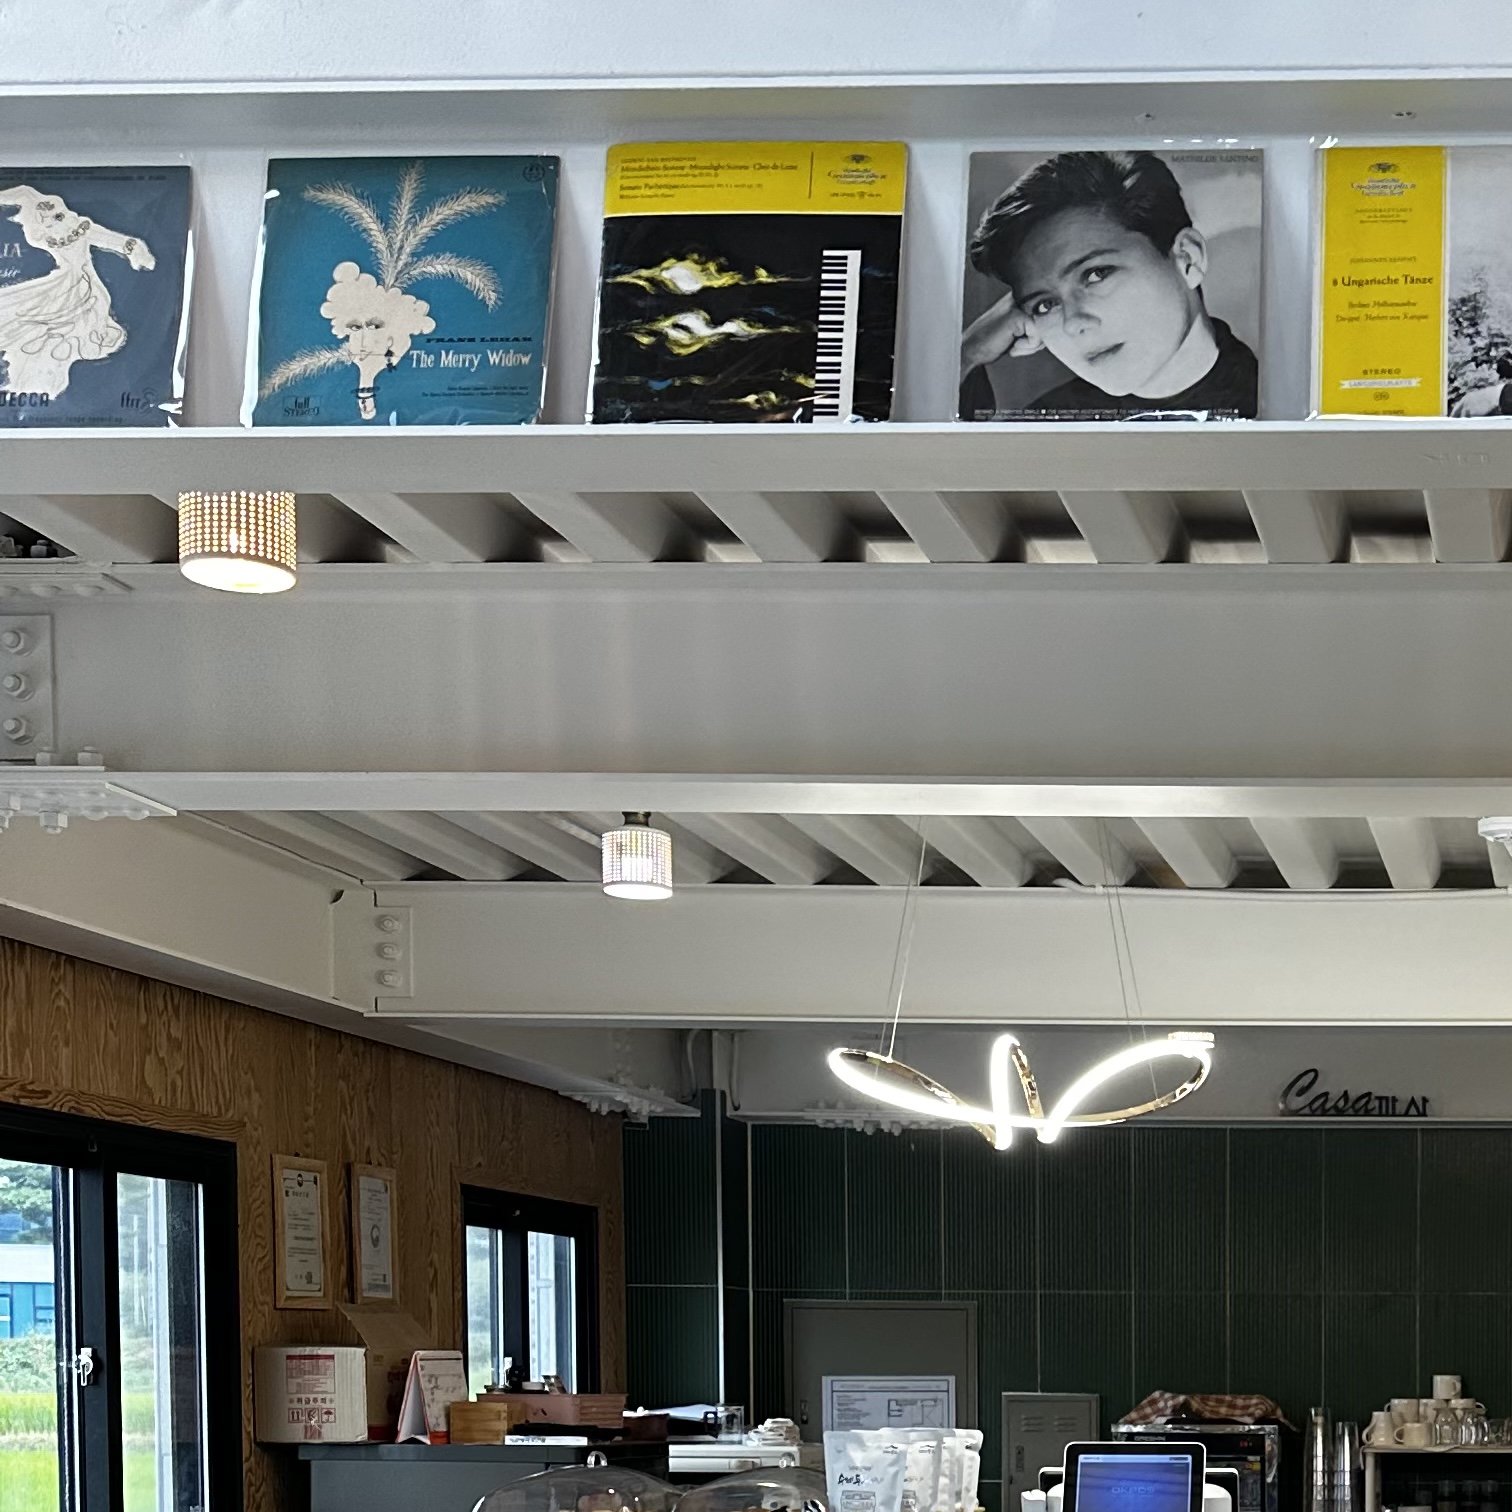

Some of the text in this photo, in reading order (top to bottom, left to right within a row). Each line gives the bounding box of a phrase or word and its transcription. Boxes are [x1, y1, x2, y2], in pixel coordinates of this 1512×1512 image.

[1341, 276, 1399, 288] Ungarische
[1402, 274, 1434, 285] Tänze
[409, 349, 532, 372] The Merry Widow
